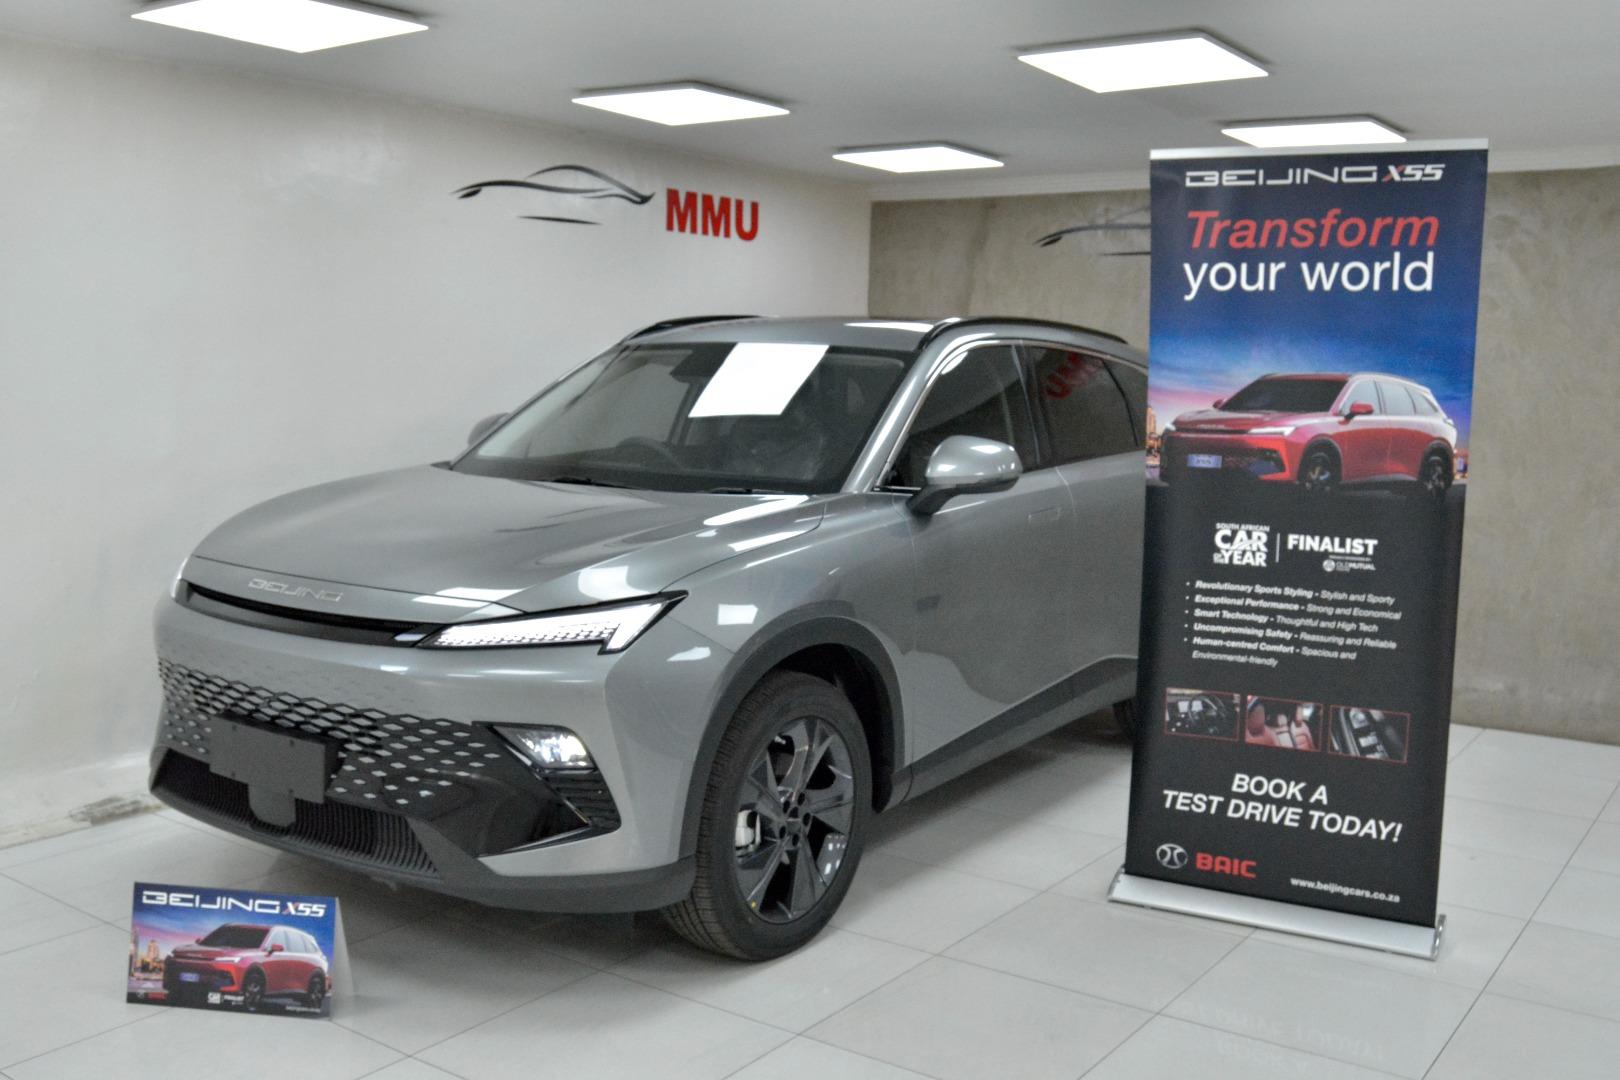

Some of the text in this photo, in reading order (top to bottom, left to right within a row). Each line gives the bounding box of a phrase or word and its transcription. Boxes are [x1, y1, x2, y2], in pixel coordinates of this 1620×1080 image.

[1185, 163, 1446, 187] BEIJING X55
[666, 187, 759, 241] MMU
[1187, 208, 1440, 249] Transform
[1183, 251, 1435, 301] your world
[1216, 522, 1270, 532] SOUTH AFRICAN
[1214, 529, 1268, 552] CAR
[1287, 533, 1378, 556] FINALIST
[1221, 549, 1267, 567] YEAR
[1195, 580, 1254, 594] Revolutionary
[1254, 584, 1283, 595] Sports
[1283, 586, 1313, 599] Styling
[1321, 589, 1348, 601] Stylish
[1349, 593, 1366, 602] and
[1366, 593, 1396, 606] Sporty
[1193, 608, 1220, 618] Smart
[1221, 609, 1269, 624] Technology
[1276, 614, 1319, 628] Thoughtful
[1319, 620, 1337, 629] and
[1336, 621, 1357, 632] High
[1358, 622, 1379, 632] Tech
[1194, 594, 1245, 606] Exceptional
[1244, 597, 1300, 611] Performance
[1306, 603, 1334, 616] Strong
[1335, 607, 1352, 616] and
[1352, 607, 1402, 620] Economical
[1192, 636, 1259, 650] Human-centred
[1259, 642, 1295, 654] Comfort
[1301, 646, 1339, 659] Spacious
[1339, 651, 1357, 660] and
[1193, 622, 1264, 637] Uncompromising
[1265, 628, 1293, 640] Safety
[1299, 631, 1345, 646] Reassuring
[1345, 637, 1363, 646] and
[1363, 637, 1397, 650] Reliable
[1231, 772, 1329, 805] BOOK A
[1162, 789, 1403, 843] TEST DRIVE TODAY!
[1195, 852, 1258, 879] BAIC
[142, 890, 281, 914] BEIJING
[1290, 877, 1400, 903] www.beijingcars.co.za
